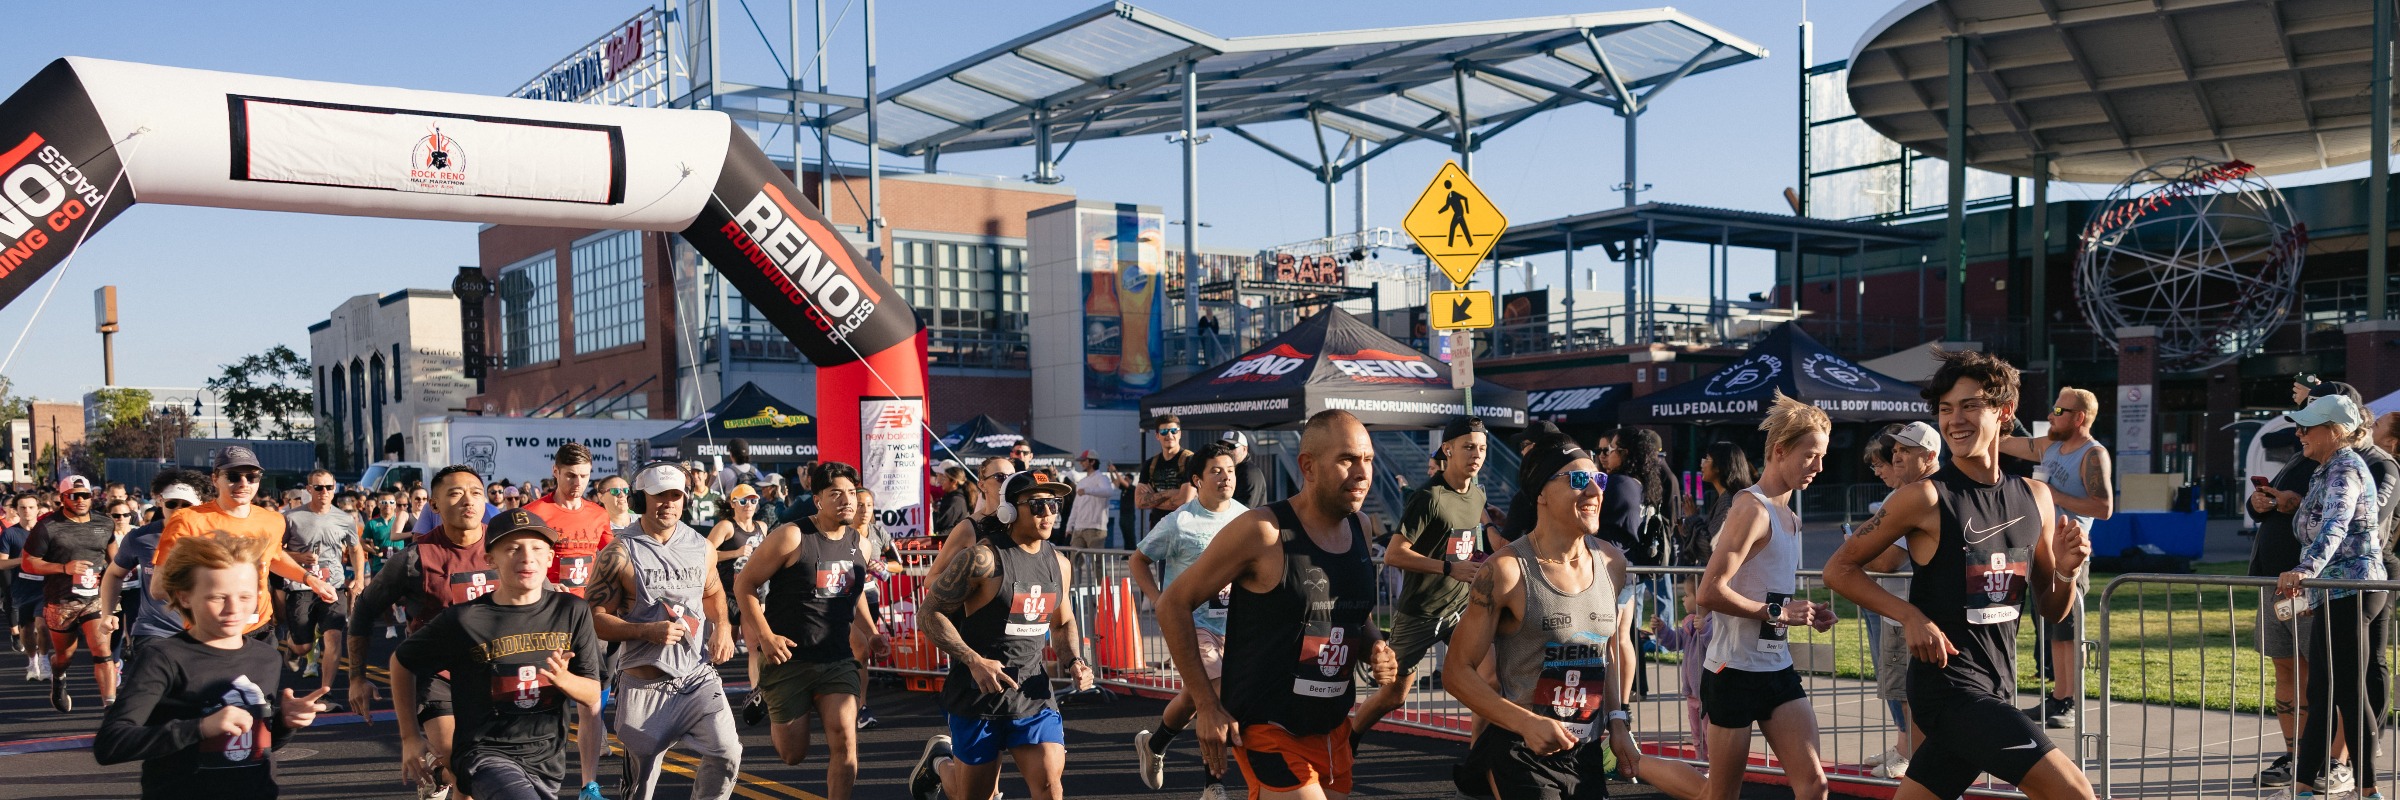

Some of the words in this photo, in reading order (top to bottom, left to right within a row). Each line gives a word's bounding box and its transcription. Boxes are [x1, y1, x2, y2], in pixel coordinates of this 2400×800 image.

[605, 20, 643, 82] Field
[37, 145, 104, 208] RACES
[411, 169, 436, 178] ROCK
[440, 172, 465, 180] RENO
[0, 229, 49, 279] ING
[47, 199, 86, 232] CO
[735, 190, 860, 318] RENO
[720, 220, 808, 306] RUNNING
[804, 303, 835, 332] CO
[1276, 253, 1338, 285] BAR
[461, 282, 484, 291] 250
[827, 298, 875, 345] RACES
[469, 309, 480, 376] LOUNGE
[420, 347, 462, 360] Gallery
[1218, 355, 1305, 379] RENO
[1332, 360, 1439, 379] RENO
[1711, 359, 1754, 382] FULL
[1758, 354, 1783, 378] PEDAL
[1802, 358, 1821, 379] FULL
[1814, 353, 1867, 378] PEDAL
[1150, 398, 1289, 417] WWW.RENORUNNINGCOMPANY.COM
[1652, 400, 1759, 416] FULLPEDAL.COM
[1814, 399, 1840, 411] FULL
[1841, 400, 1869, 411] BODY
[1871, 401, 1910, 412] INDOOR
[1911, 402, 1932, 413] CYC
[724, 417, 772, 429] LEPRECHAUN
[789, 415, 810, 427] RACE
[505, 437, 540, 447] TWO
[583, 437, 612, 448] AND
[865, 432, 885, 441] new
[592, 454, 614, 462] Who
[895, 452, 909, 460] AND
[690, 499, 715, 527] 12
[910, 507, 920, 526] 11
[1455, 541, 1474, 554] 506
[826, 573, 847, 587] 224
[1983, 569, 2014, 592] 397
[1023, 597, 1046, 614] 614
[1542, 616, 1572, 629] RENO
[1982, 612, 1997, 620] Beer
[1318, 643, 1349, 666] 520
[517, 680, 541, 700] 14
[1309, 684, 1327, 693] Beer
[1551, 685, 1588, 708] 194
[227, 729, 253, 751] 20
